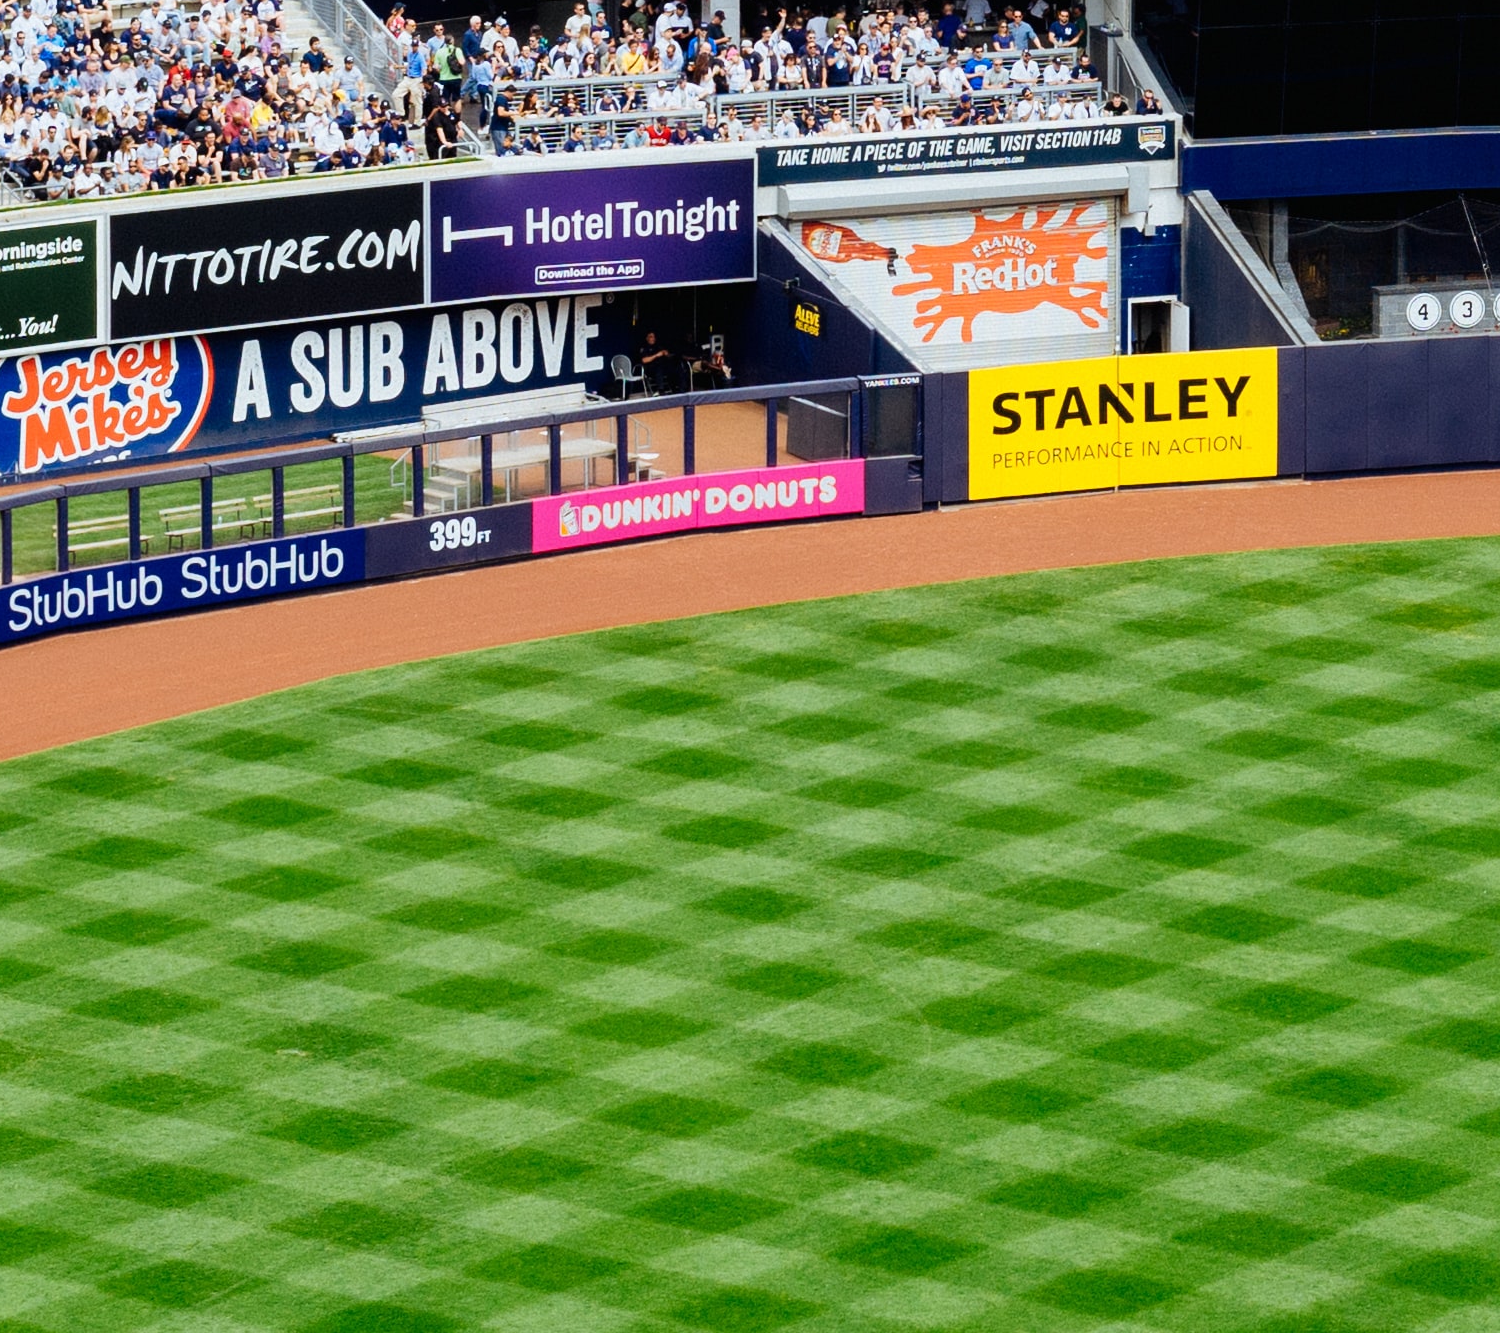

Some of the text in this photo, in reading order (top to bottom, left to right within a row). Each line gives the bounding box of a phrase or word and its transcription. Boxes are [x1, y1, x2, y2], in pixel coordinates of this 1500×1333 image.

[776, 128, 1121, 167] TAKE HOME A PIECE OF THE GAME, VISIT SECTION 114B
[112, 218, 422, 300] NITTOTIRE.COM
[539, 264, 640, 279] Download the App
[2, 338, 178, 418] Jersey
[233, 296, 602, 422] A SUB ABOVE
[20, 385, 181, 473] Mike's
[993, 376, 1250, 435] STANLEY
[993, 435, 1242, 469] PERFORMANCE IN ACTION
[582, 476, 837, 531] DUNKIN' DONUTS
[430, 517, 491, 551] 399 FT
[8, 571, 163, 635] StubHub
[180, 538, 345, 603] StubHub
